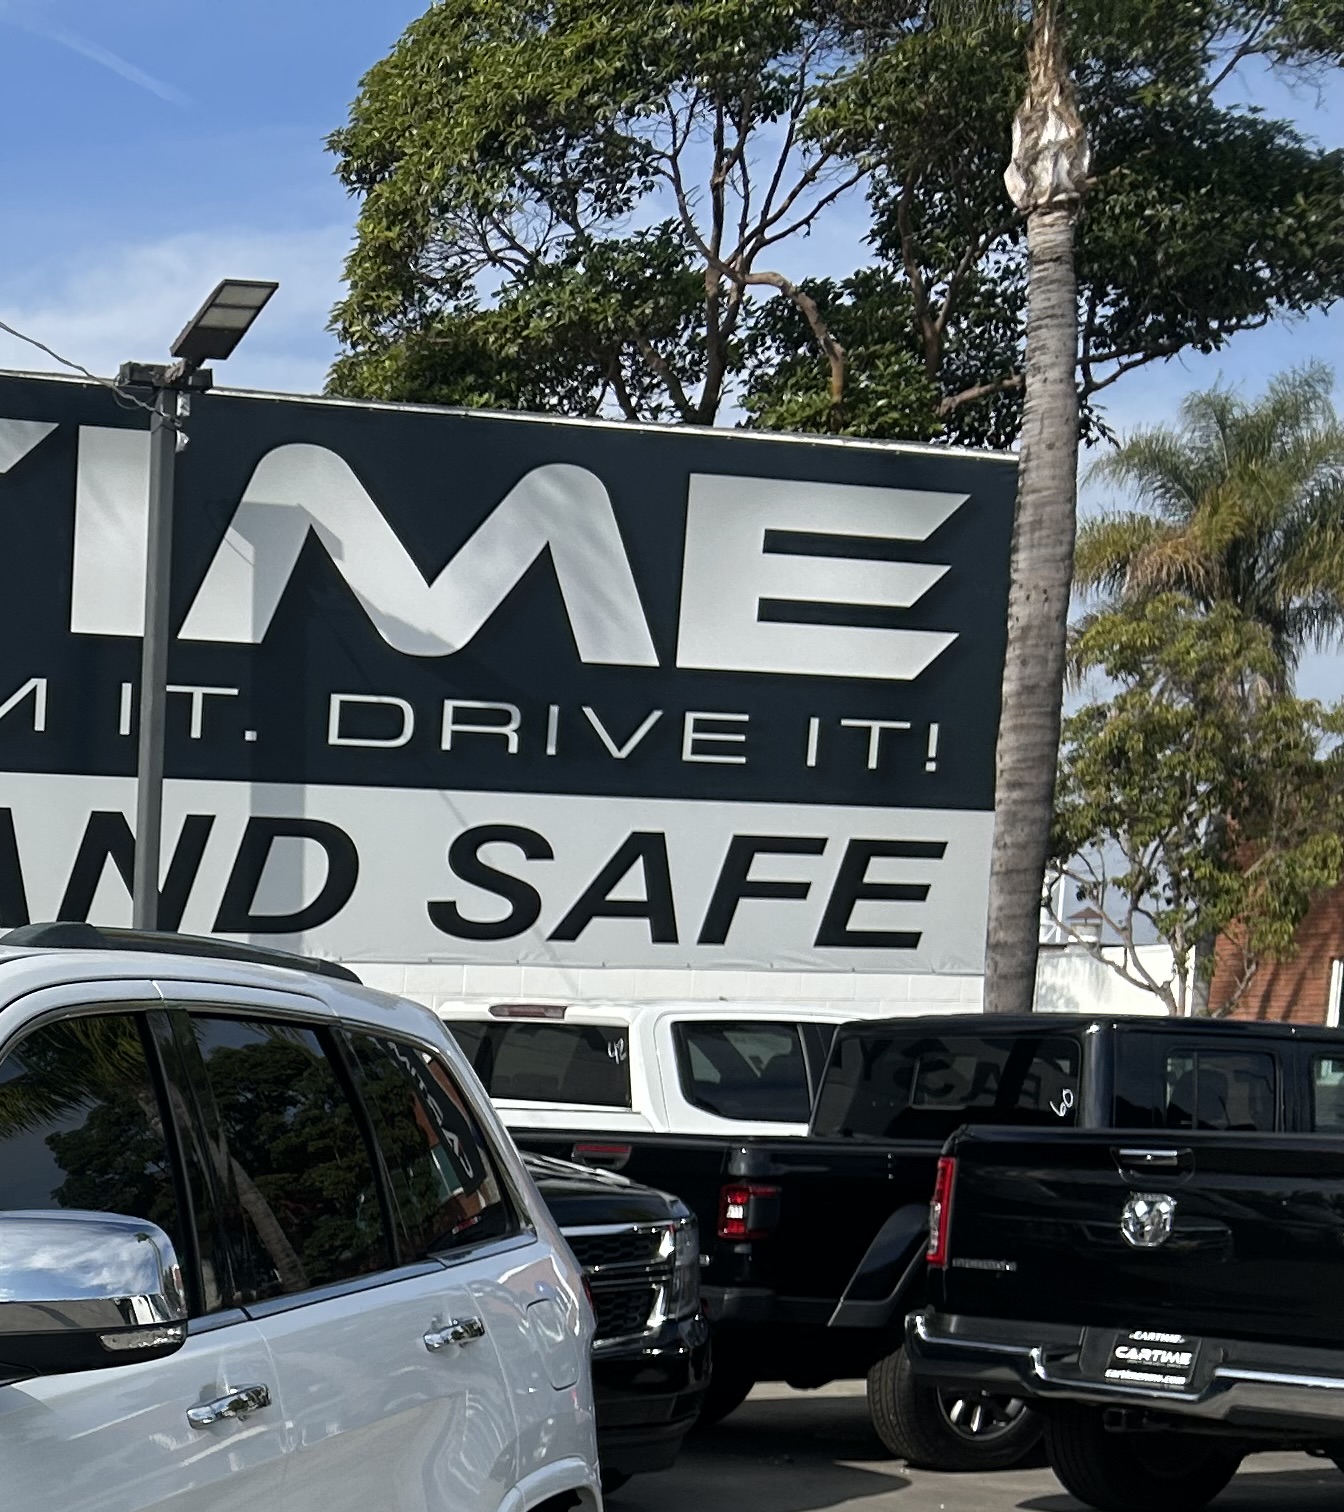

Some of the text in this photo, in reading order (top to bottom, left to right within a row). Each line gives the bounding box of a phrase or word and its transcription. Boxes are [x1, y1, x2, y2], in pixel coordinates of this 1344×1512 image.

[120, 682, 258, 742] IT.
[327, 692, 751, 766] DRIVE
[806, 715, 940, 774] IT!
[426, 823, 949, 950] SAFE
[1115, 1346, 1192, 1365] CARTIME
